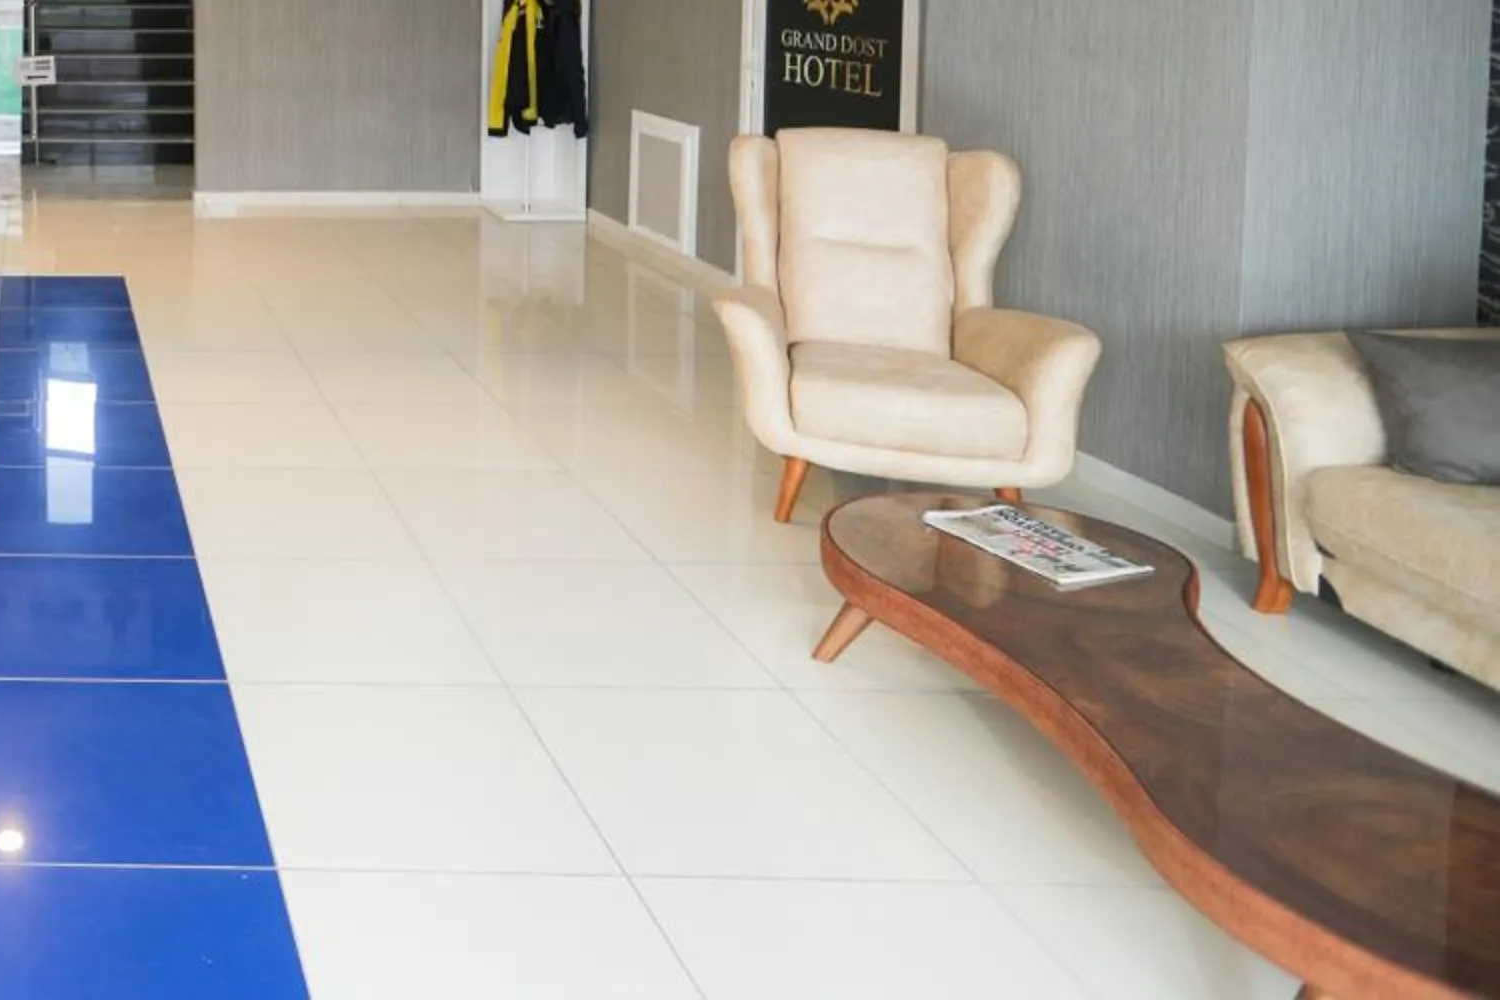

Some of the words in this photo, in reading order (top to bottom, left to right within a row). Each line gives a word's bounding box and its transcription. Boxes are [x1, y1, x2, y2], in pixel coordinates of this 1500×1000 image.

[780, 28, 838, 52] GRAND
[840, 34, 889, 59] DOST
[782, 52, 883, 98] HOTEL
